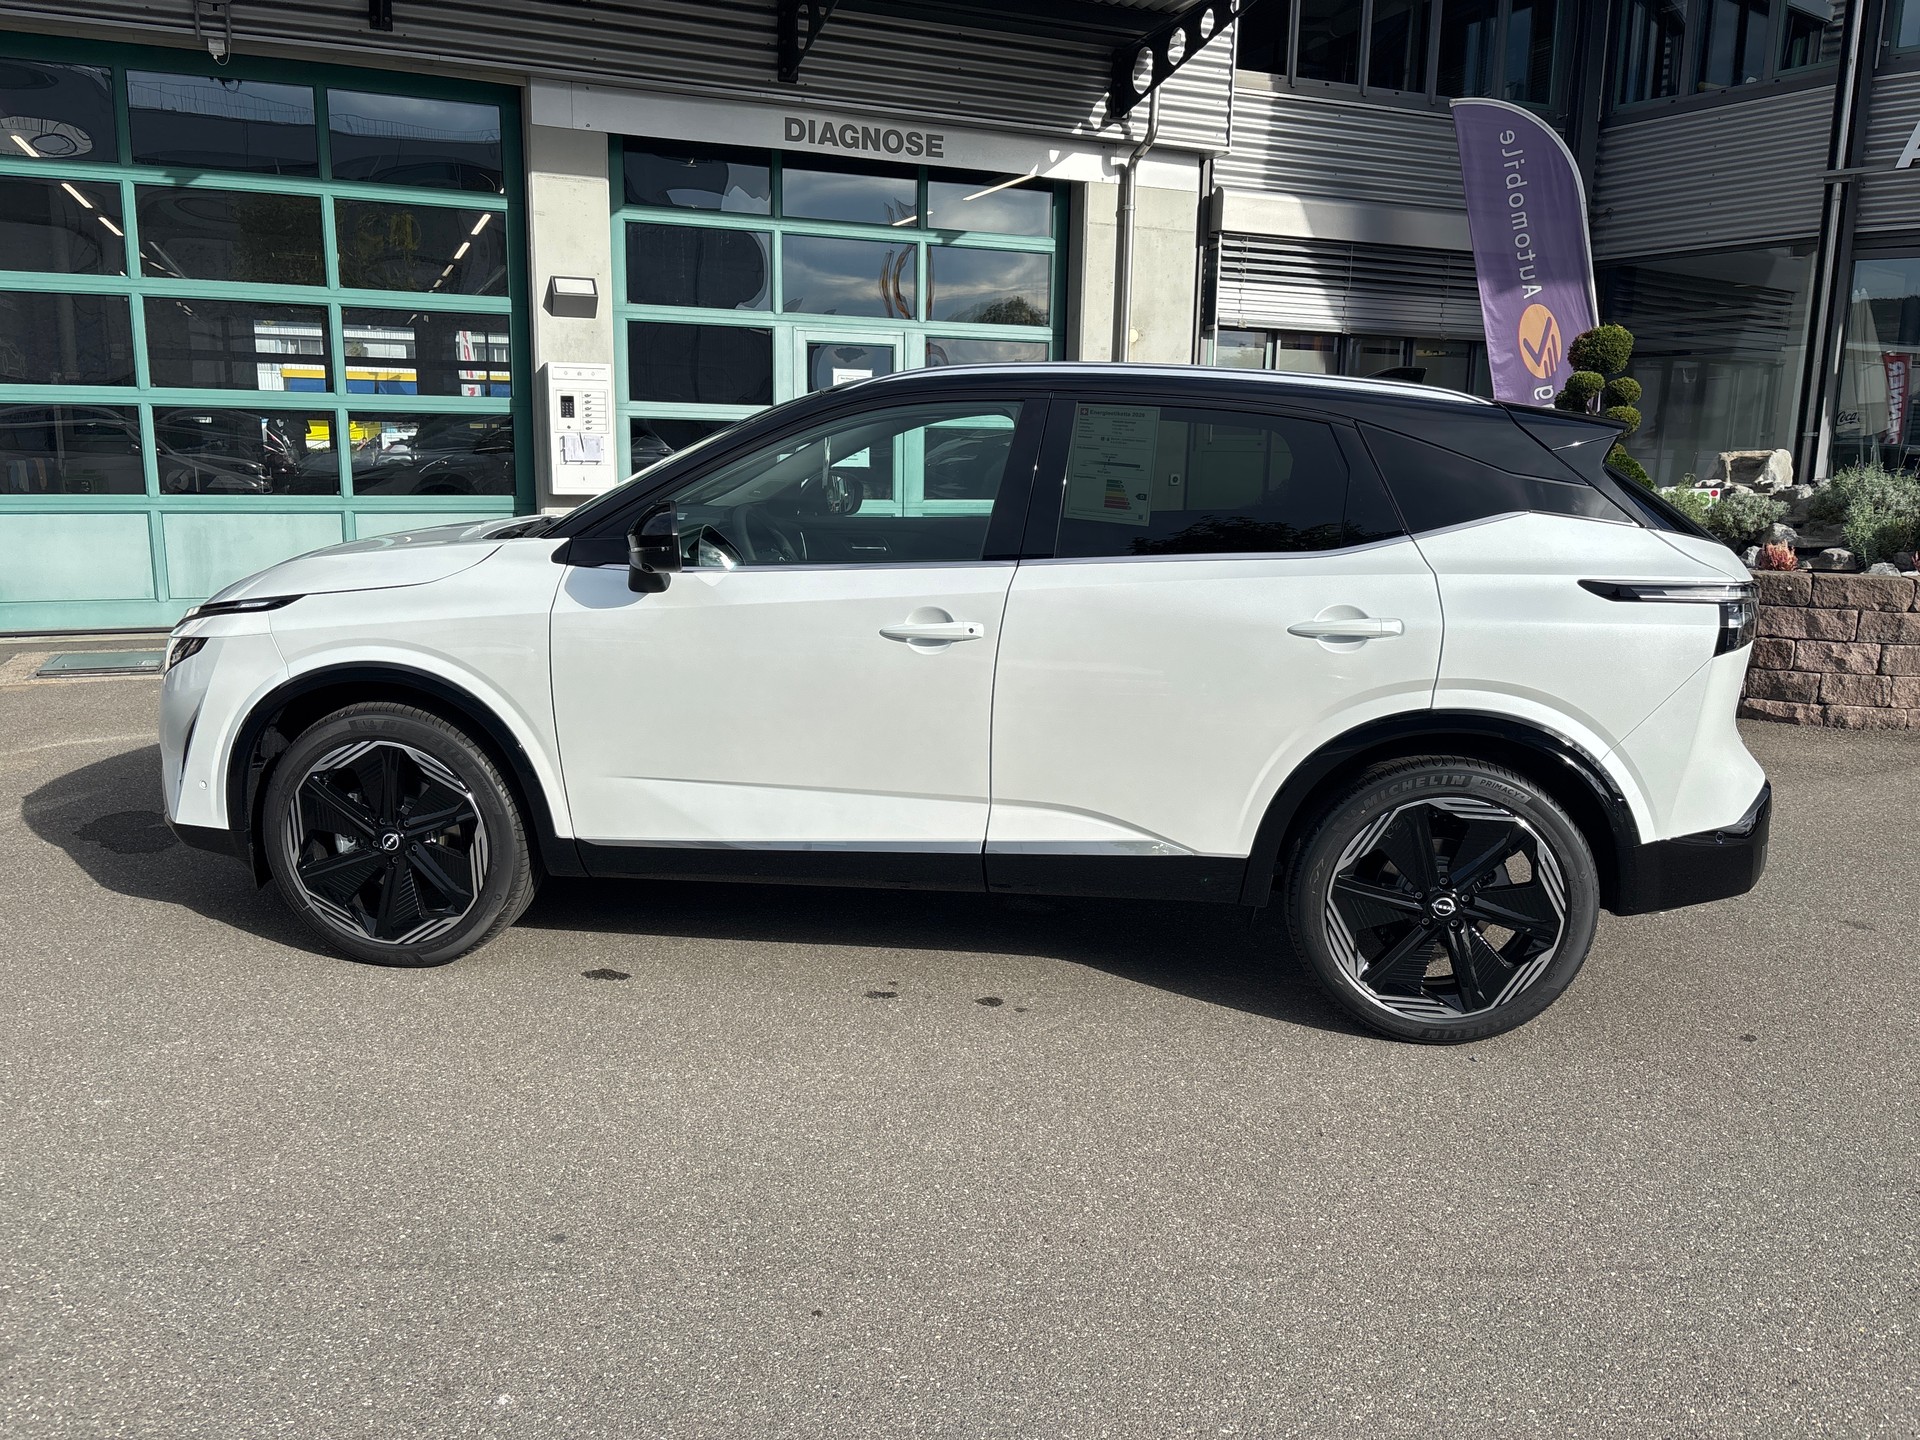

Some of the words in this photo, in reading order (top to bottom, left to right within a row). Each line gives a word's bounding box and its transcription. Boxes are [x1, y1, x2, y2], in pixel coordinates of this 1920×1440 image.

[785, 116, 944, 158] DIAGNOSE
[1363, 775, 1466, 811] MICHELIN
[1479, 779, 1520, 797] PRIMACY
